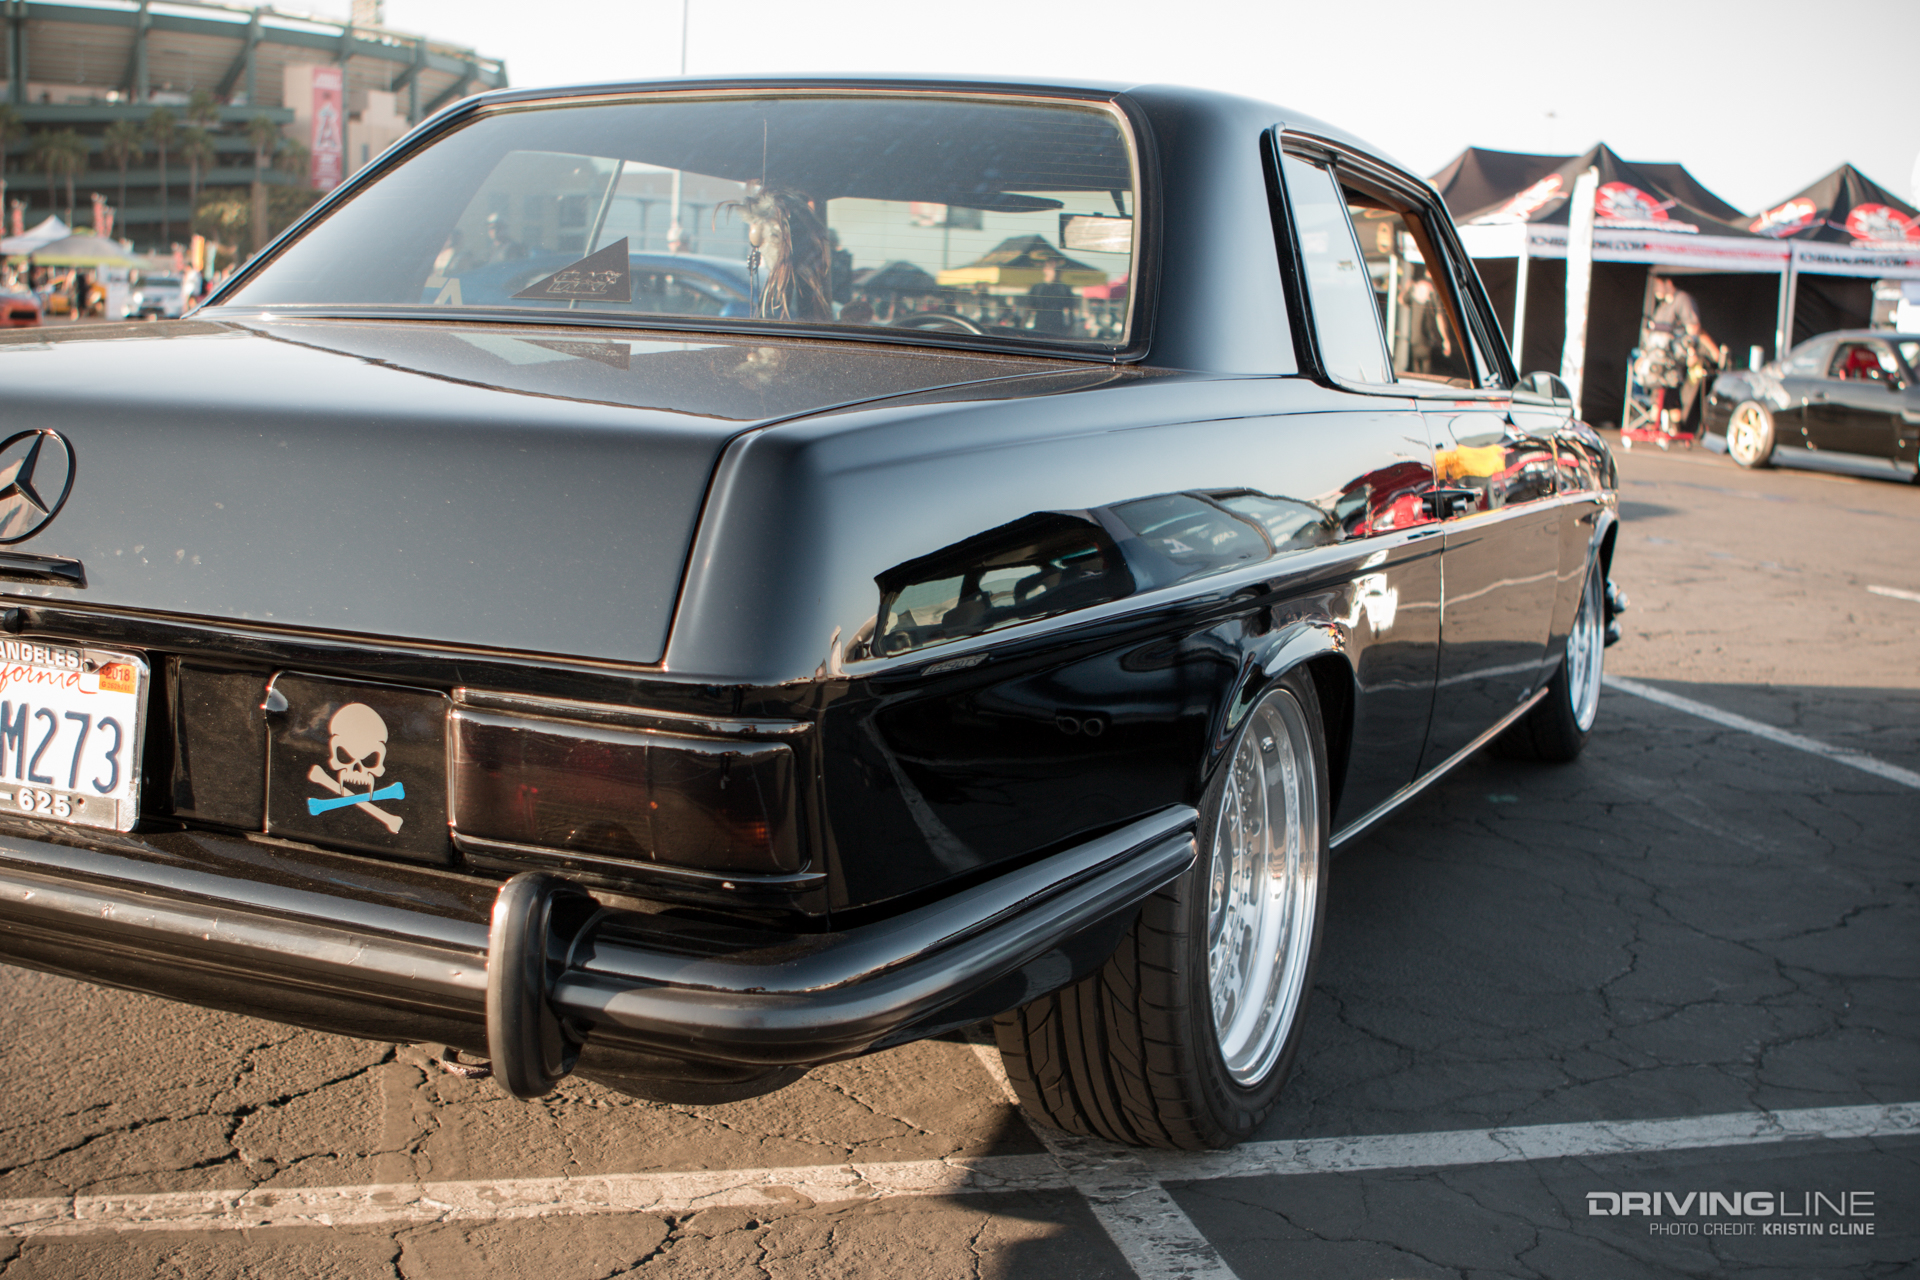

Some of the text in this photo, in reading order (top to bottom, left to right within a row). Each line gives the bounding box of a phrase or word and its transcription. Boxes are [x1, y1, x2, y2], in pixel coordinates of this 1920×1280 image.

[0, 641, 80, 668] ANGELES
[105, 666, 131, 682] 2018
[0, 700, 122, 794] M273
